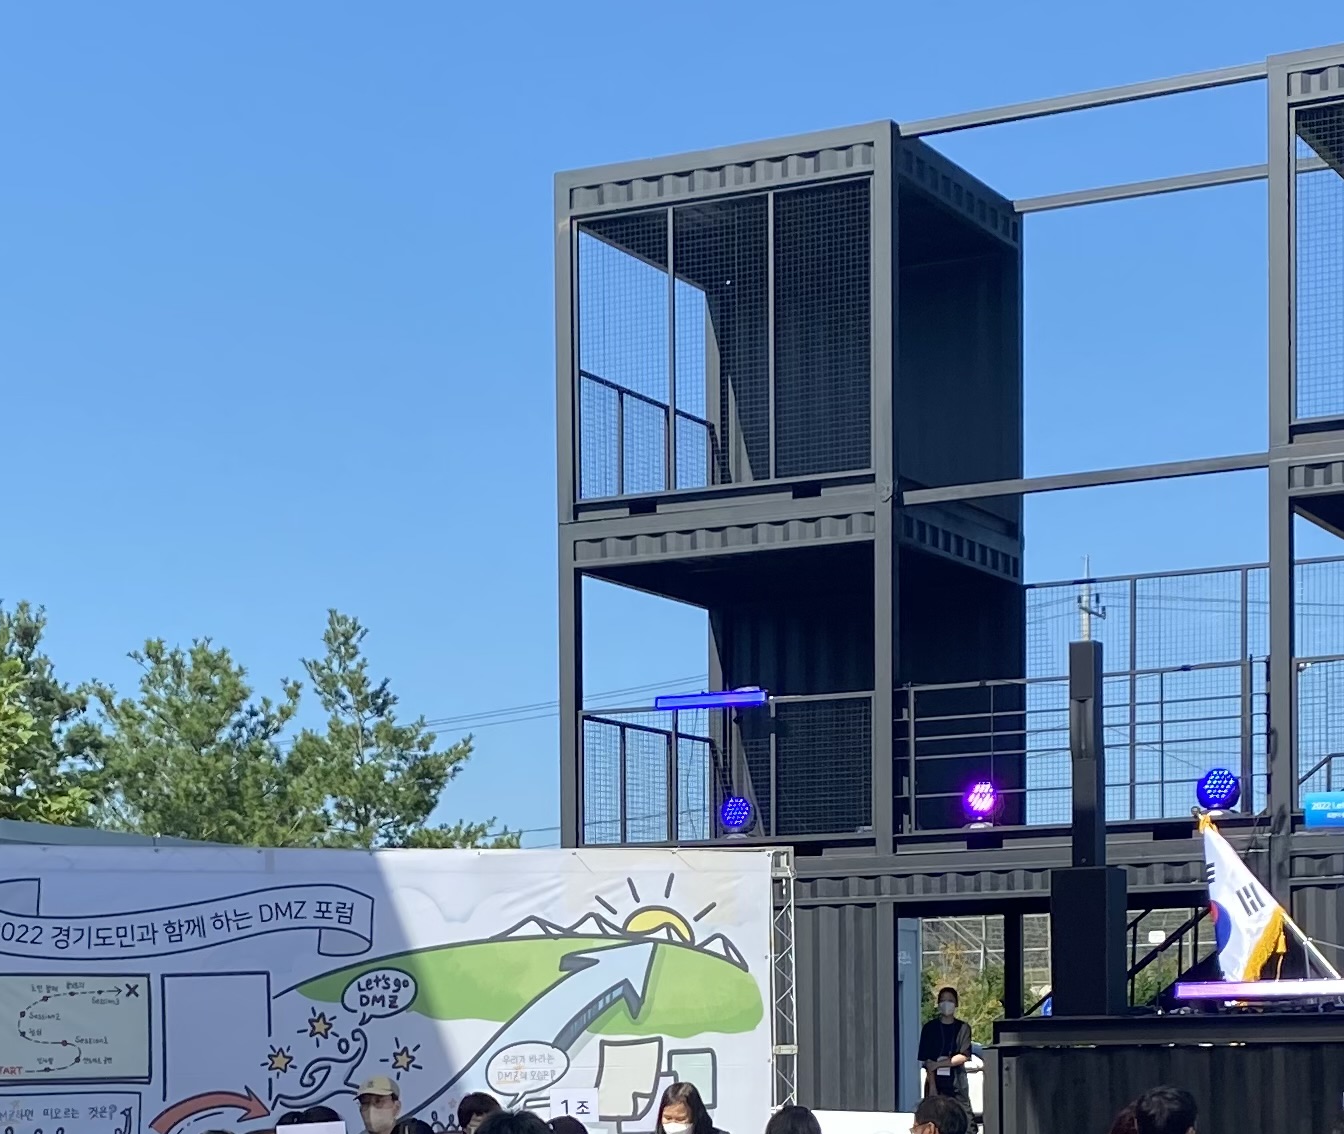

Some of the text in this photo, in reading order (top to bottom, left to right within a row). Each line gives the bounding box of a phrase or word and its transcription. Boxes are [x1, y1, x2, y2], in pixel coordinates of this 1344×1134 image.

[51, 923, 158, 950] 경기도민과
[163, 915, 207, 943] 함께
[212, 908, 253, 932] 하는
[259, 901, 307, 924] DMZ
[312, 901, 355, 925] 포럼
[357, 974, 410, 993] Let's go
[359, 994, 399, 1009] DMZ
[560, 1099, 591, 1115] 1 조
